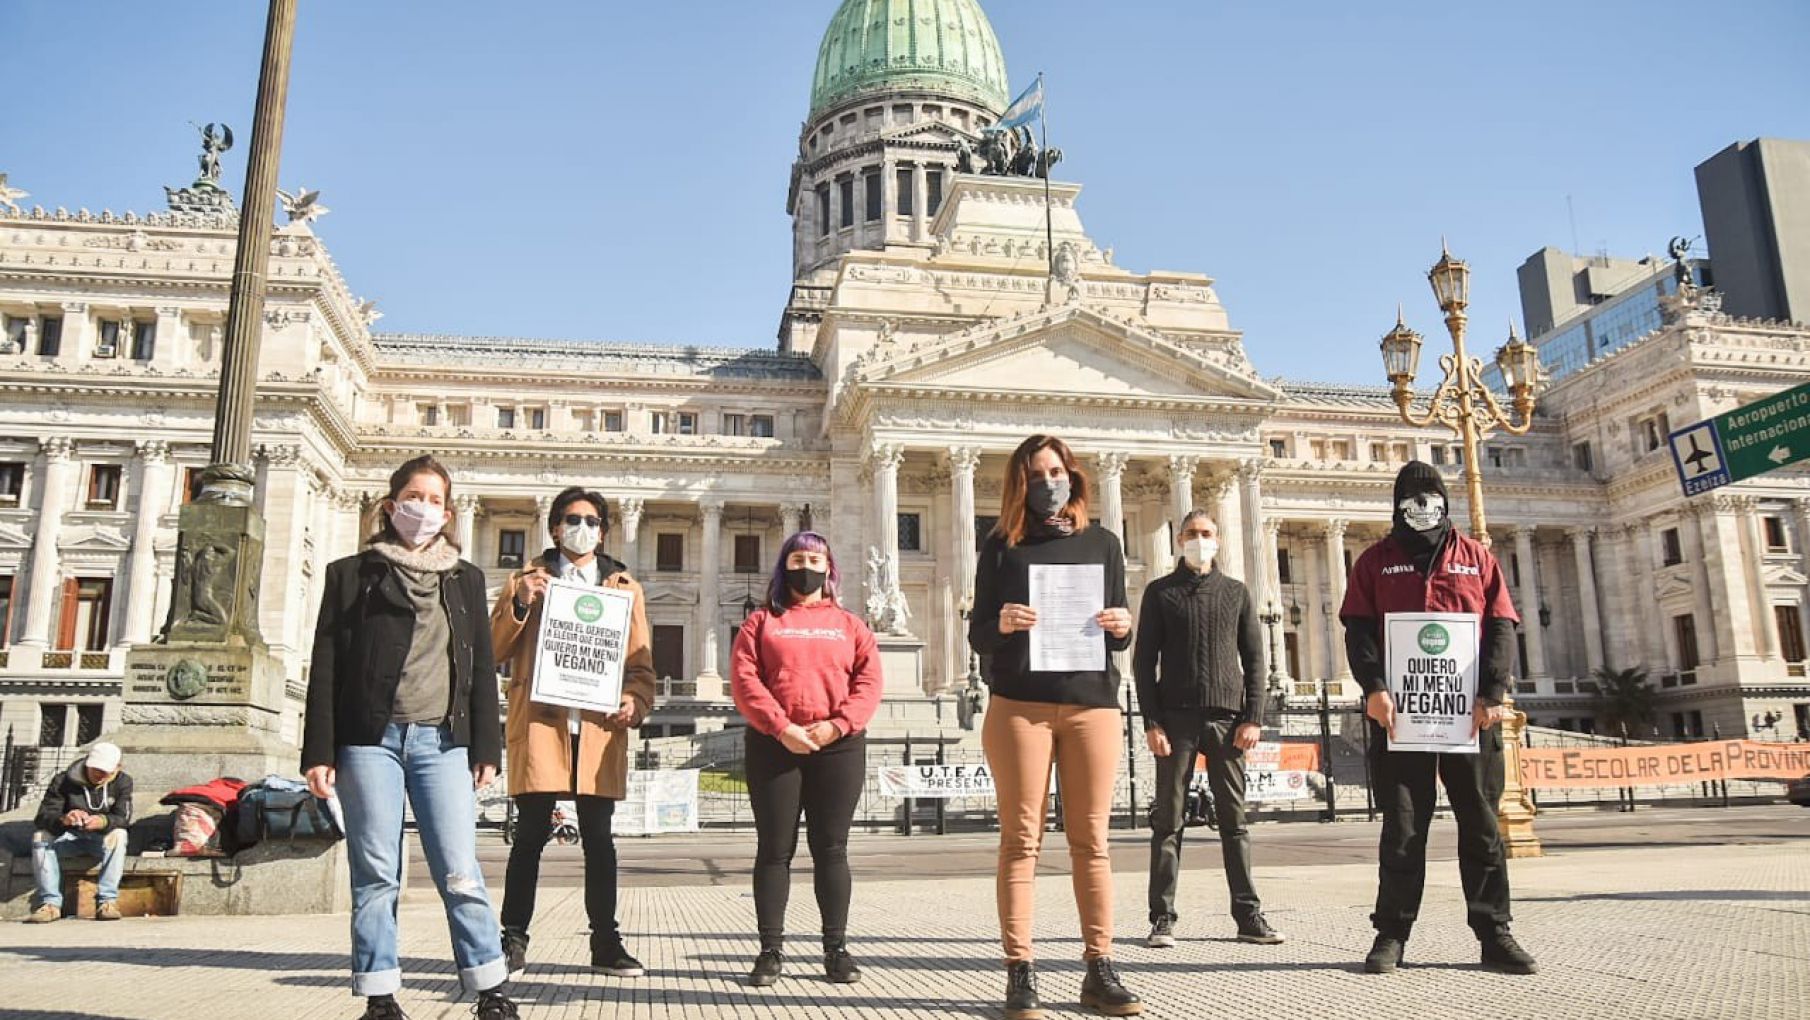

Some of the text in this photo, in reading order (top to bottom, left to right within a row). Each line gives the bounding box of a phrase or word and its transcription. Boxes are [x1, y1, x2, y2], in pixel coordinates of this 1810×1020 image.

[1728, 392, 1808, 430] Aeropuerto
[1685, 473, 1727, 495] Ezeiza
[546, 628, 552, 637] A
[554, 630, 578, 642] ELEGIR
[550, 618, 621, 640] TENGO EL DERECHO
[545, 639, 578, 656] QUIERO
[580, 645, 591, 657] MI
[554, 652, 608, 676] VEGANO.
[1408, 658, 1457, 674] QUIERO
[1403, 673, 1463, 692] MI MENÚ
[1395, 692, 1472, 715] VEGANO.
[1563, 752, 1660, 779] ESCOLAR
